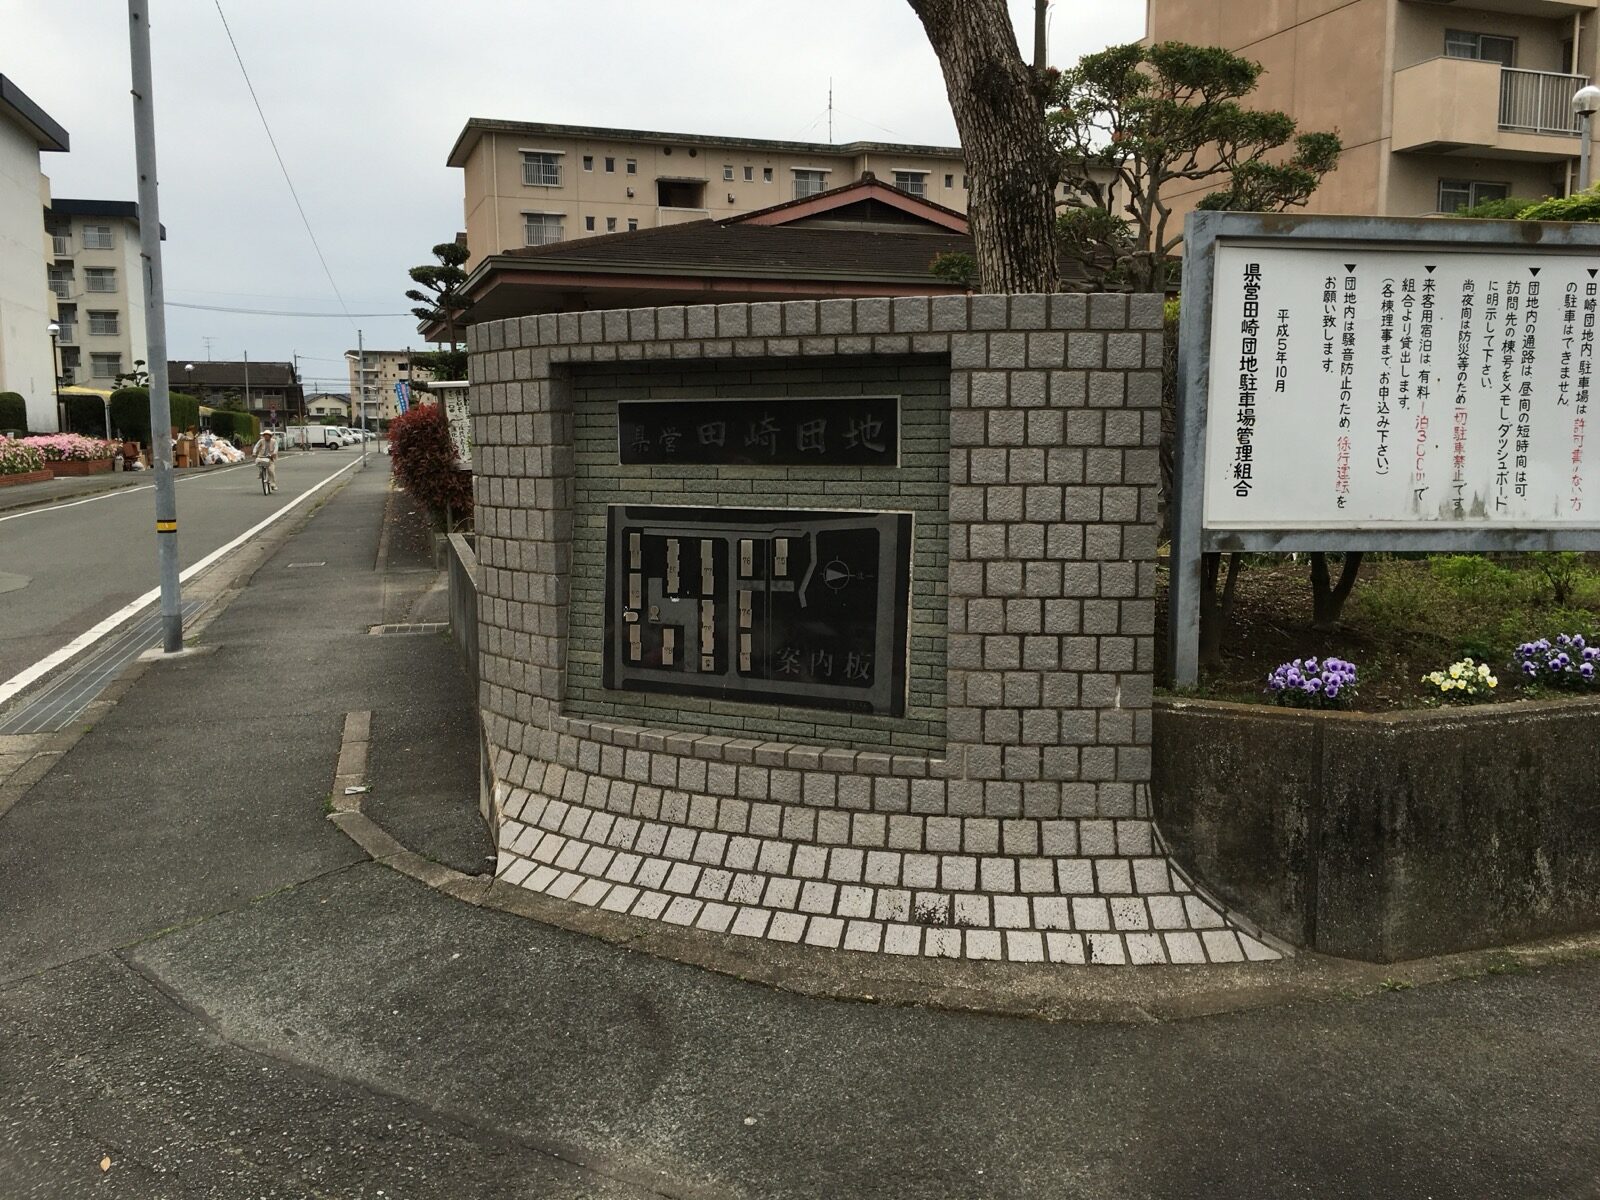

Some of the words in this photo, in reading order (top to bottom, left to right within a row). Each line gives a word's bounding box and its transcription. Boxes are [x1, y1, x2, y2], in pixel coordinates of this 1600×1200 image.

[1233, 262, 1263, 498] 県営田崎団地駐車場管理組合
[1274, 308, 1290, 393] 平成5年10月
[776, 647, 873, 680] 案内板
